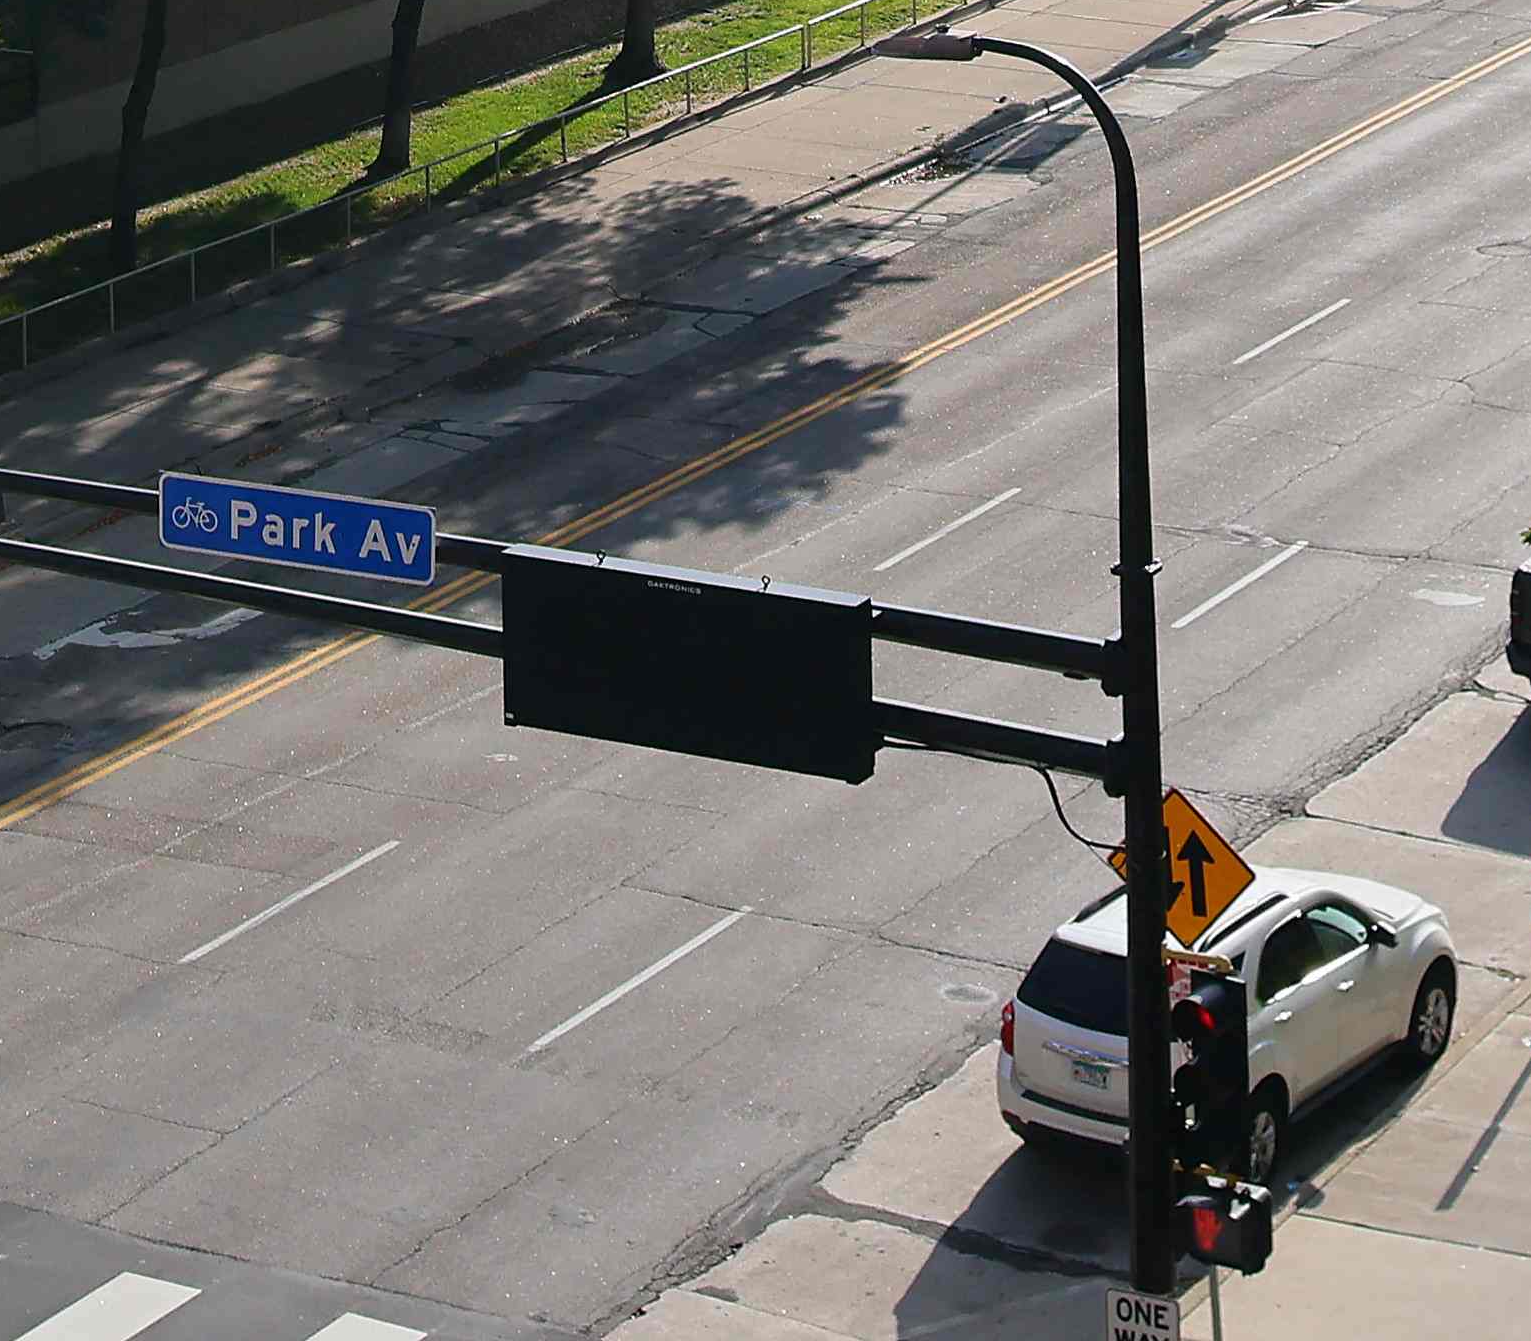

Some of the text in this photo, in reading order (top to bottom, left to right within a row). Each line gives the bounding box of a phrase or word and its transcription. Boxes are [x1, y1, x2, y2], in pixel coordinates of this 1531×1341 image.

[230, 499, 421, 566] Park Av
[1116, 1297, 1170, 1331] ONE
